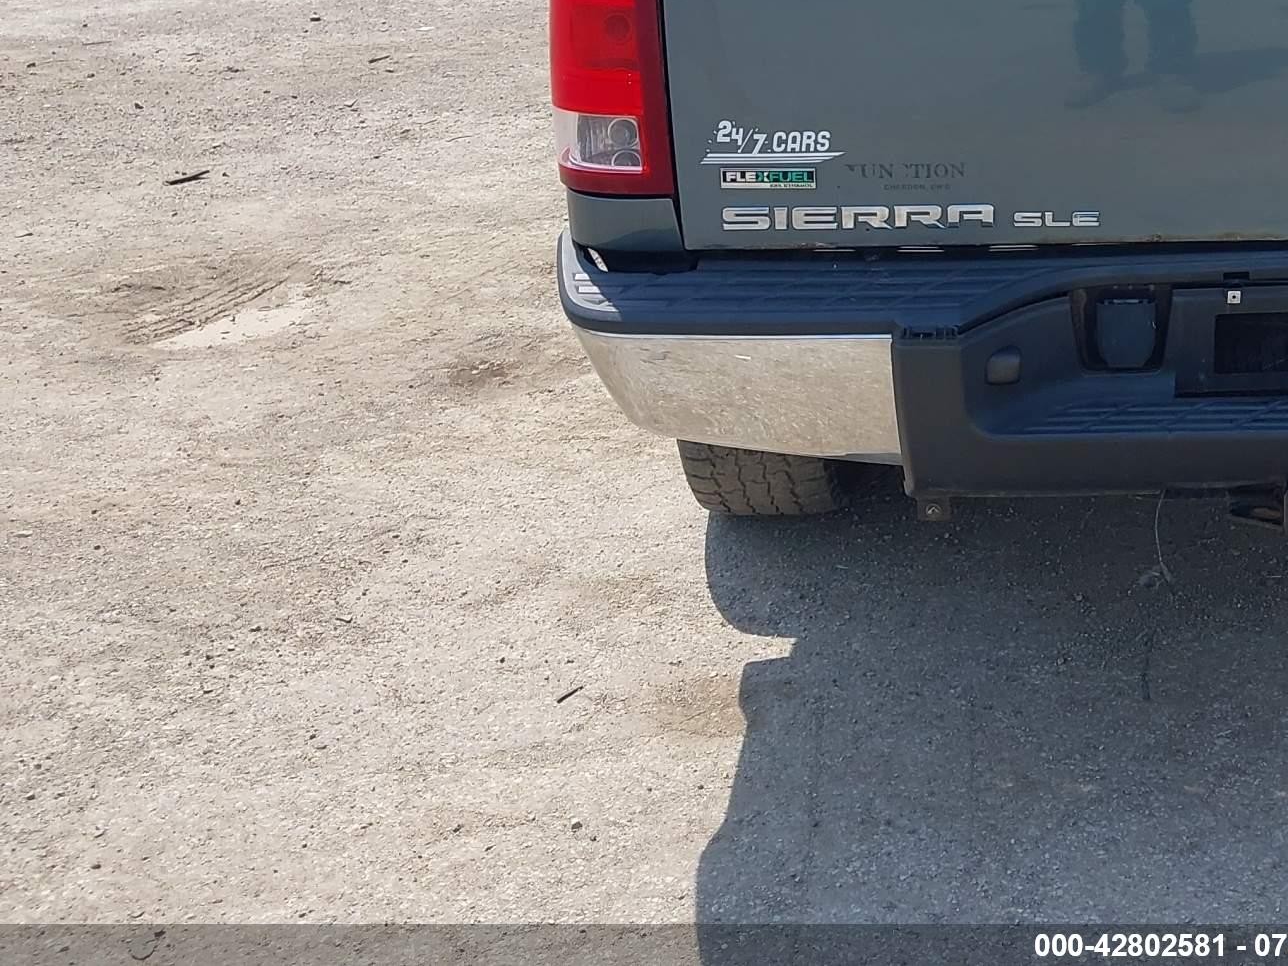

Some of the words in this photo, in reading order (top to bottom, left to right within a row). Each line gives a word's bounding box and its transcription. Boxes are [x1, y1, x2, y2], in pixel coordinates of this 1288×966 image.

[716, 120, 768, 155] 24/7
[772, 131, 831, 153] CARS
[722, 203, 996, 231] SIERRA
[1013, 210, 1101, 228] SLE
